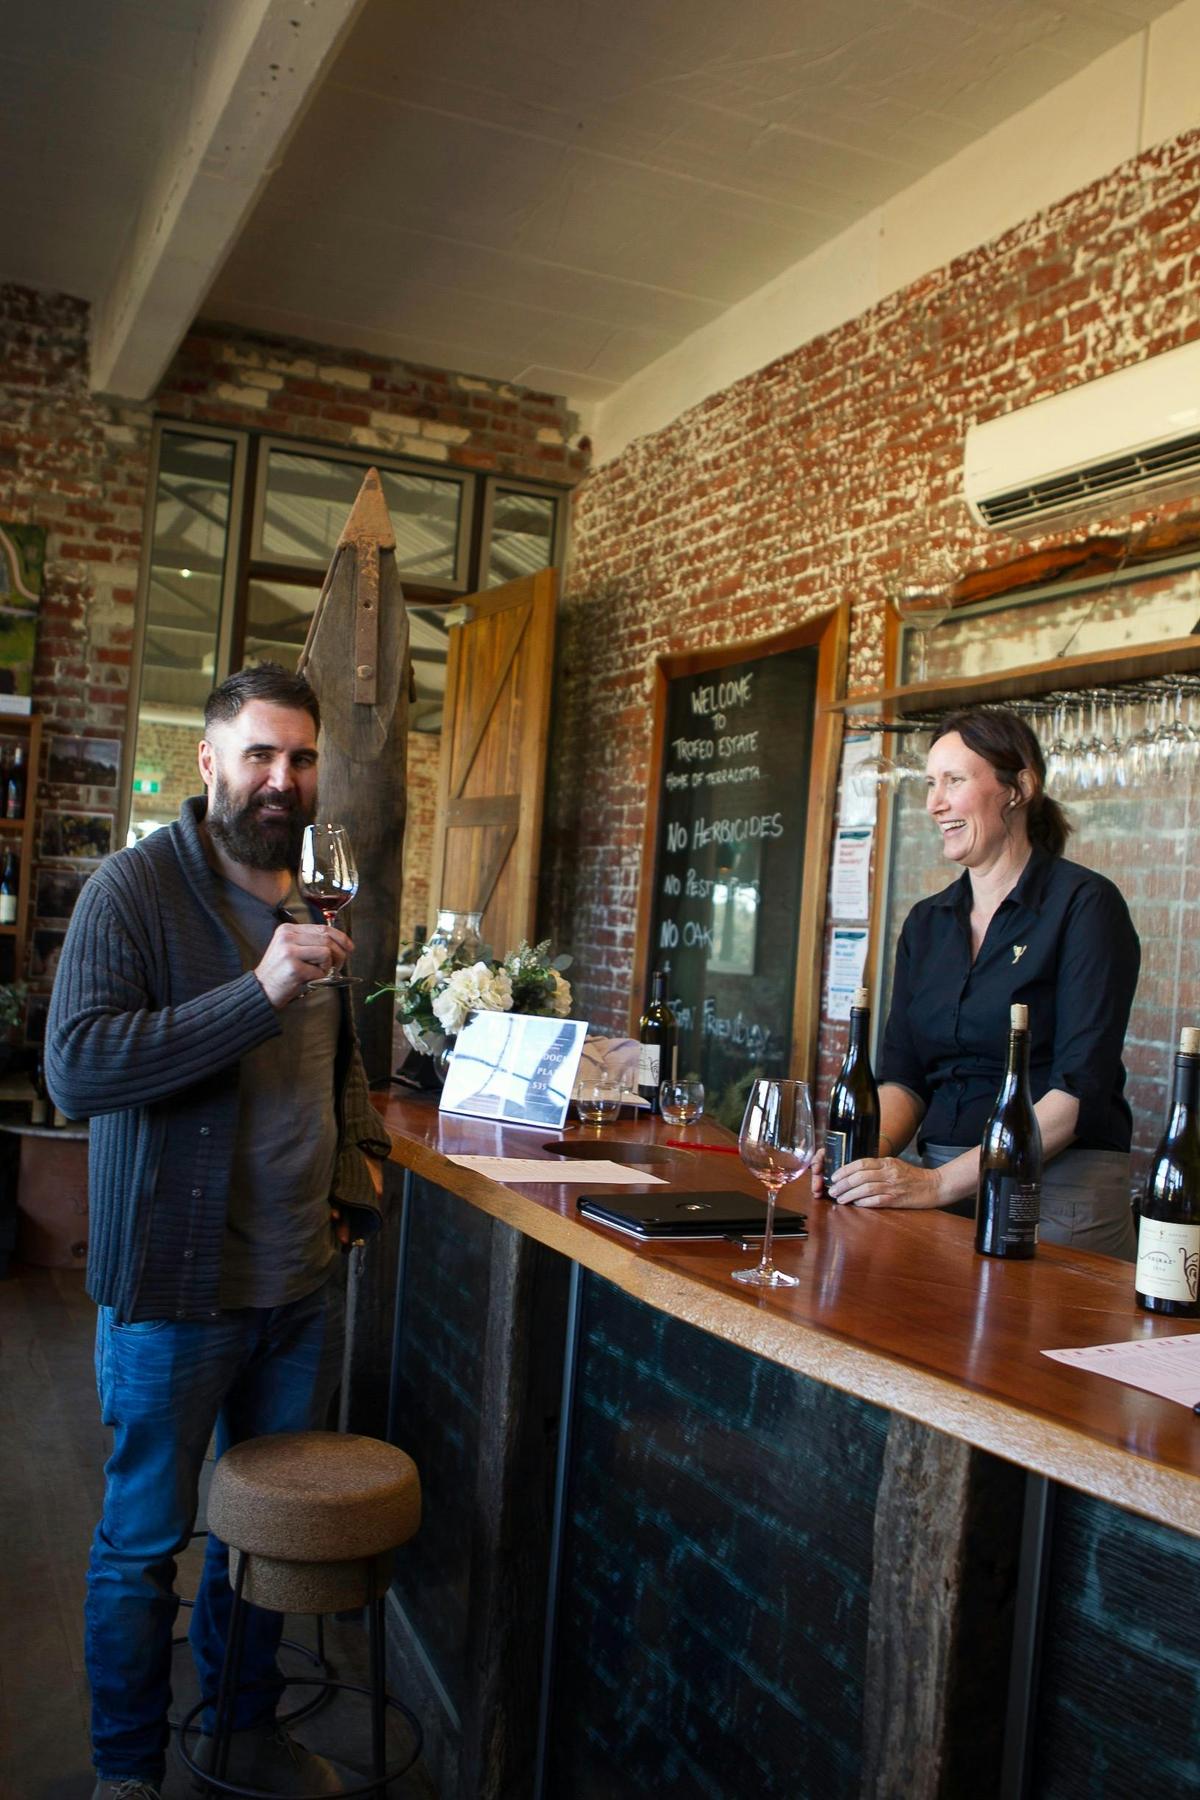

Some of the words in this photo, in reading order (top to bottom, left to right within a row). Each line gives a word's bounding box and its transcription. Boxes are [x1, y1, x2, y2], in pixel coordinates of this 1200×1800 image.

[691, 672, 754, 714] WELCOME
[711, 712, 727, 730] TO
[672, 738, 714, 762] TROFEO
[718, 731, 759, 757] ESTATE
[691, 772, 704, 787] OF
[667, 821, 688, 852] NO
[692, 812, 784, 850] HERBICIDES
[664, 874, 681, 895] NO
[660, 919, 679, 948] NO
[683, 921, 715, 950] OAK
